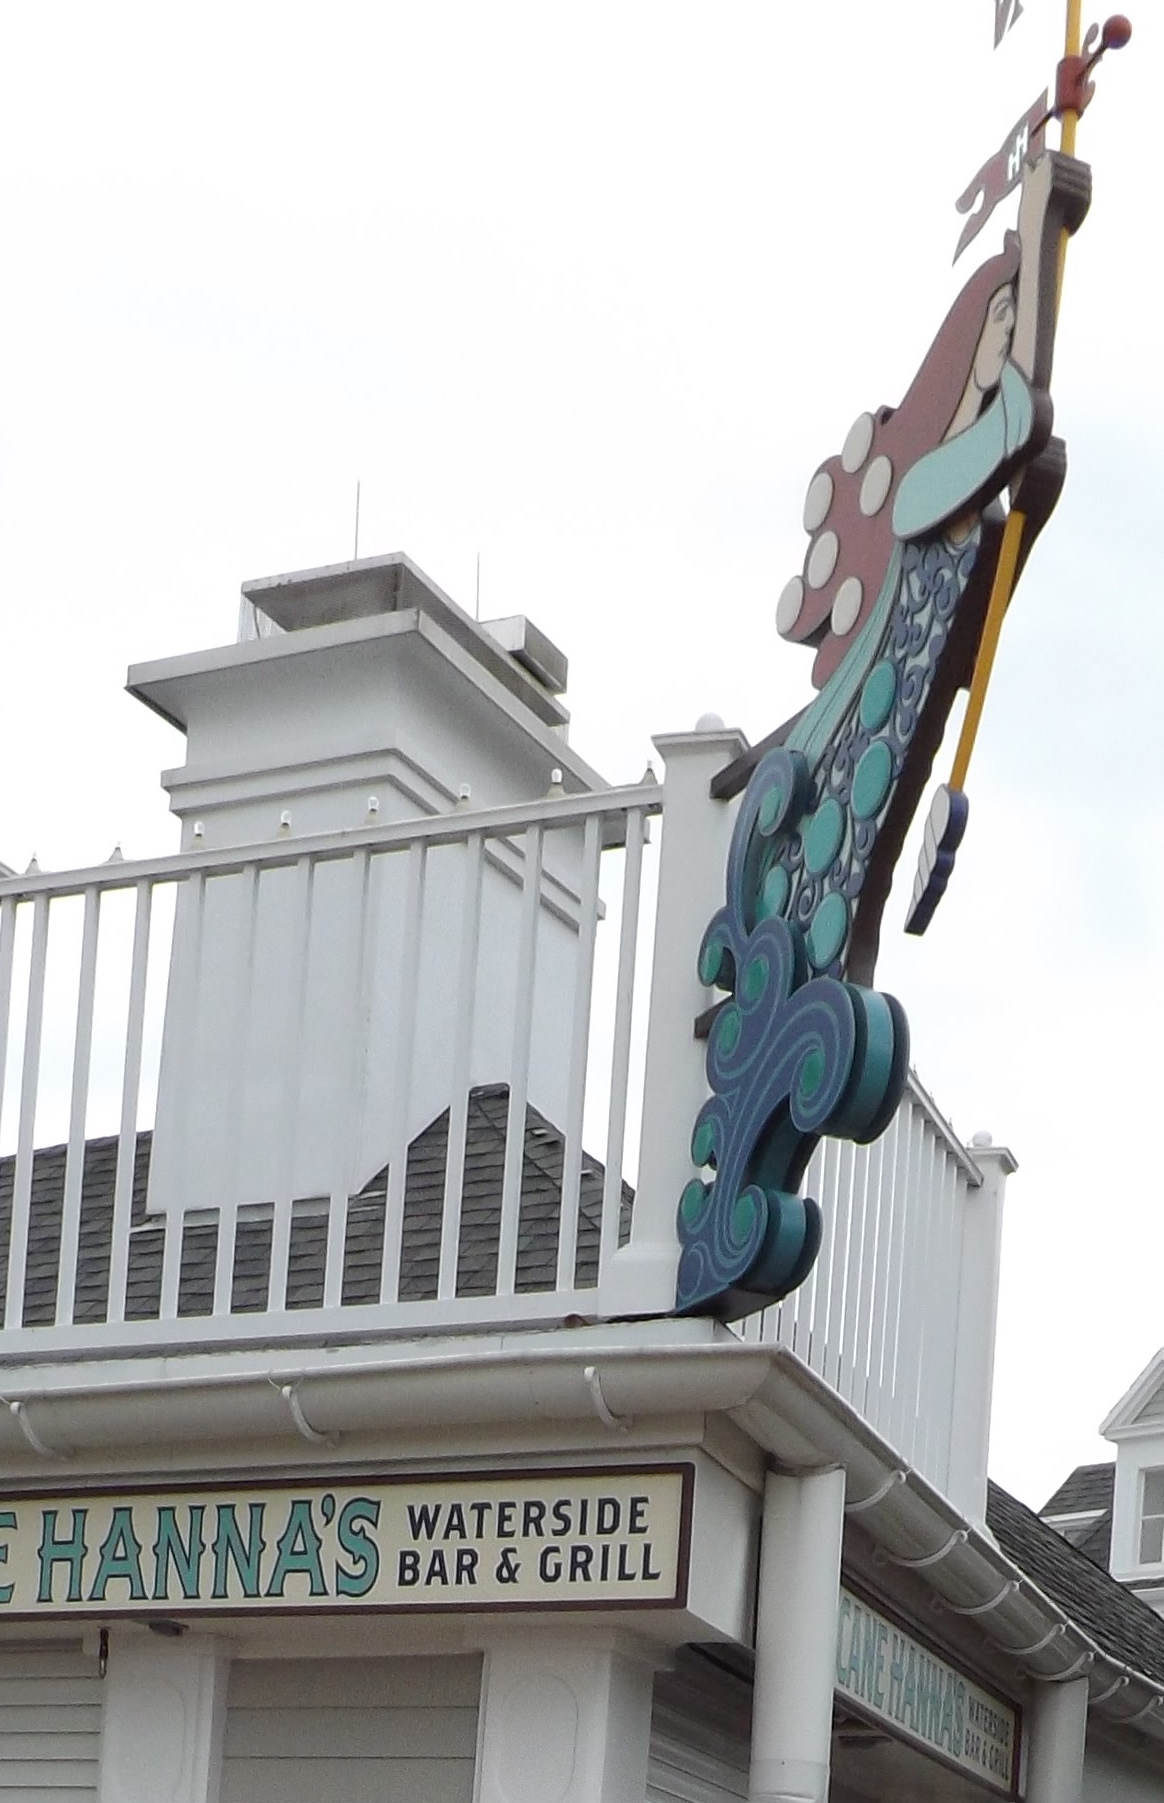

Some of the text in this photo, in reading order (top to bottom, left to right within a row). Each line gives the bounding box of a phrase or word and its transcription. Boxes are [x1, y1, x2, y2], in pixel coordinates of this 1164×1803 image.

[406, 1496, 650, 1541] WATERSIDE
[36, 1493, 382, 1602] HANNA'S
[397, 1542, 662, 1586] BAR & GRILL
[887, 1633, 966, 1758] HANNA'S
[968, 1695, 1011, 1748] WATERSIDE
[964, 1727, 981, 1761] BAR
[989, 1744, 1009, 1781] GRILL
